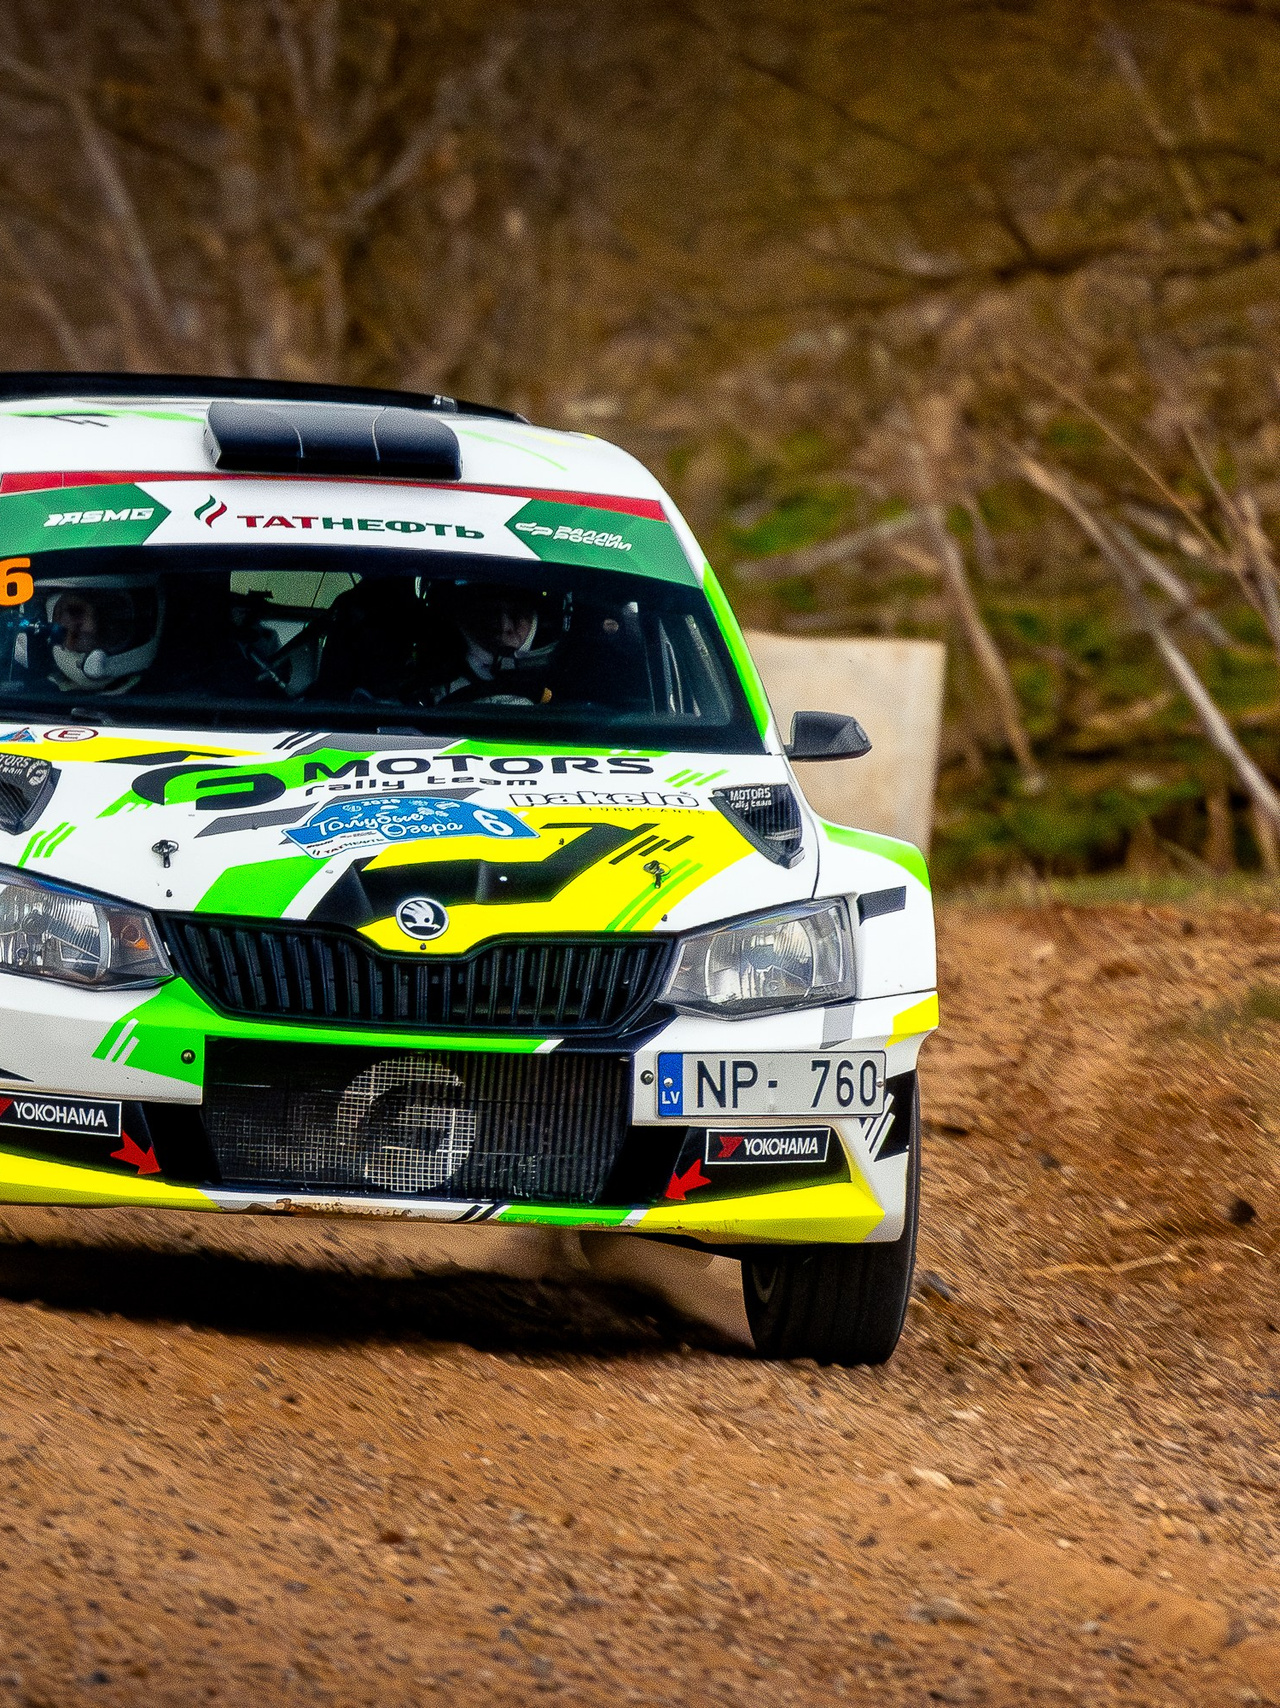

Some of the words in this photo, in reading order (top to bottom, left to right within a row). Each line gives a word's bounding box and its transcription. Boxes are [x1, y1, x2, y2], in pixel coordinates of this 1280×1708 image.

[236, 514, 485, 540] ТАТНЕФТЬ
[303, 754, 655, 784] MOTORS
[305, 778, 405, 797] rally
[427, 775, 539, 787] team
[729, 786, 772, 801] MOTORS
[509, 790, 700, 808] pakelo
[472, 809, 515, 836] 6
[810, 1059, 878, 1109] 760
[661, 1090, 681, 1105] LV
[13, 1101, 109, 1128] YOKOHAMA
[743, 1136, 819, 1157] YOKOHAMA
